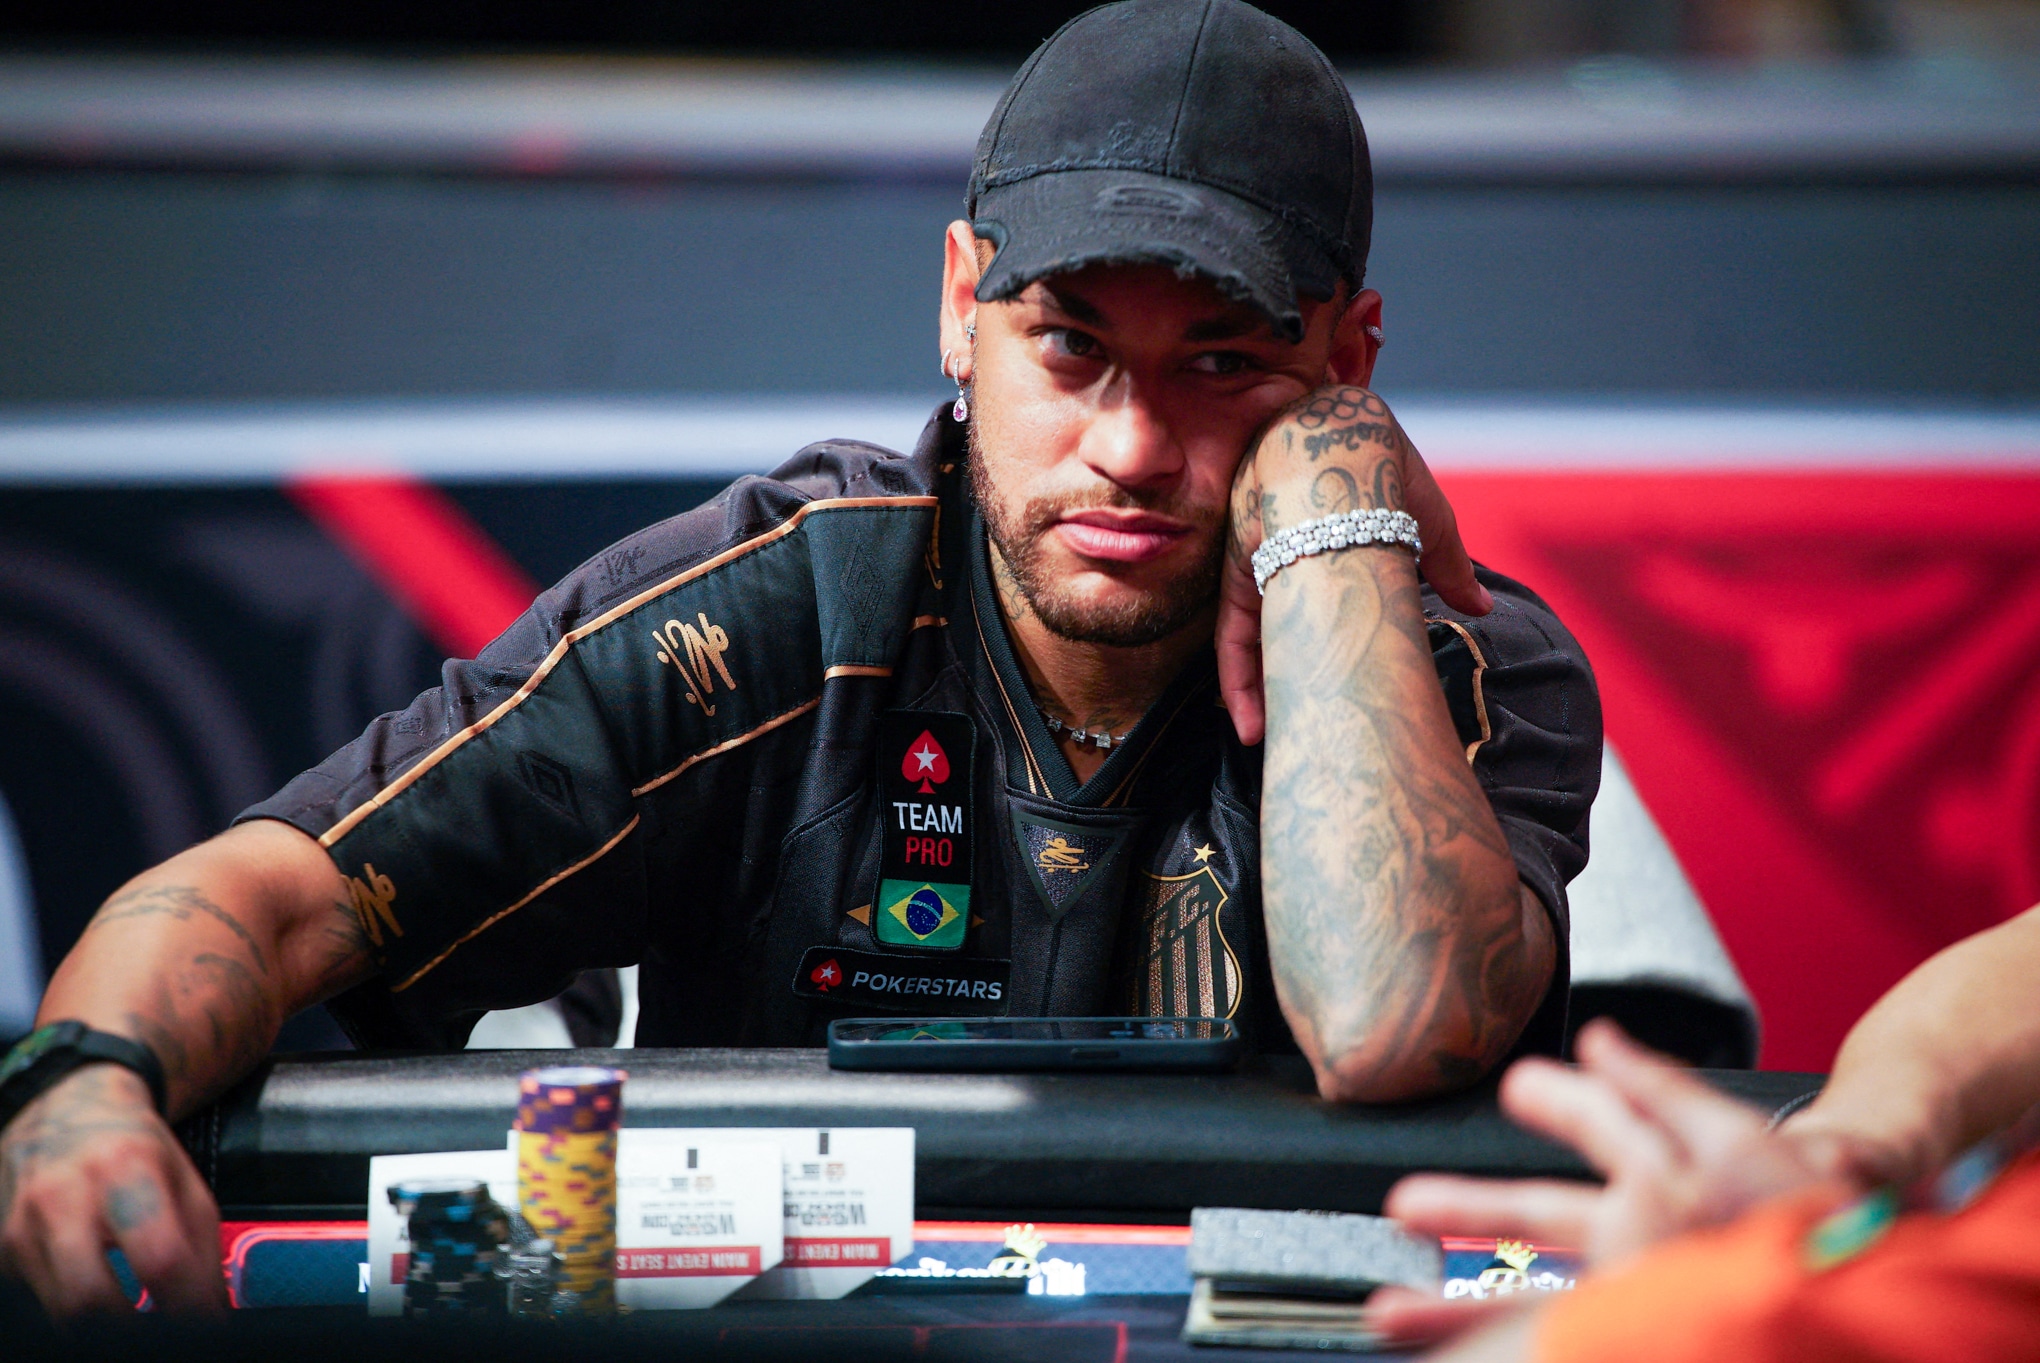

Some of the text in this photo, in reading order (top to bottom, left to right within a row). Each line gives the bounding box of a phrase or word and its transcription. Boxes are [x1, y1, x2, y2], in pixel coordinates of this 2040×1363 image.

[893, 802, 963, 834] TEAM
[905, 836, 953, 867] PRO
[852, 971, 1003, 1001] POKERSTARS
[630, 1254, 665, 1270] SEAT
[667, 1253, 710, 1269] EVENT
[711, 1253, 750, 1269] MAIN
